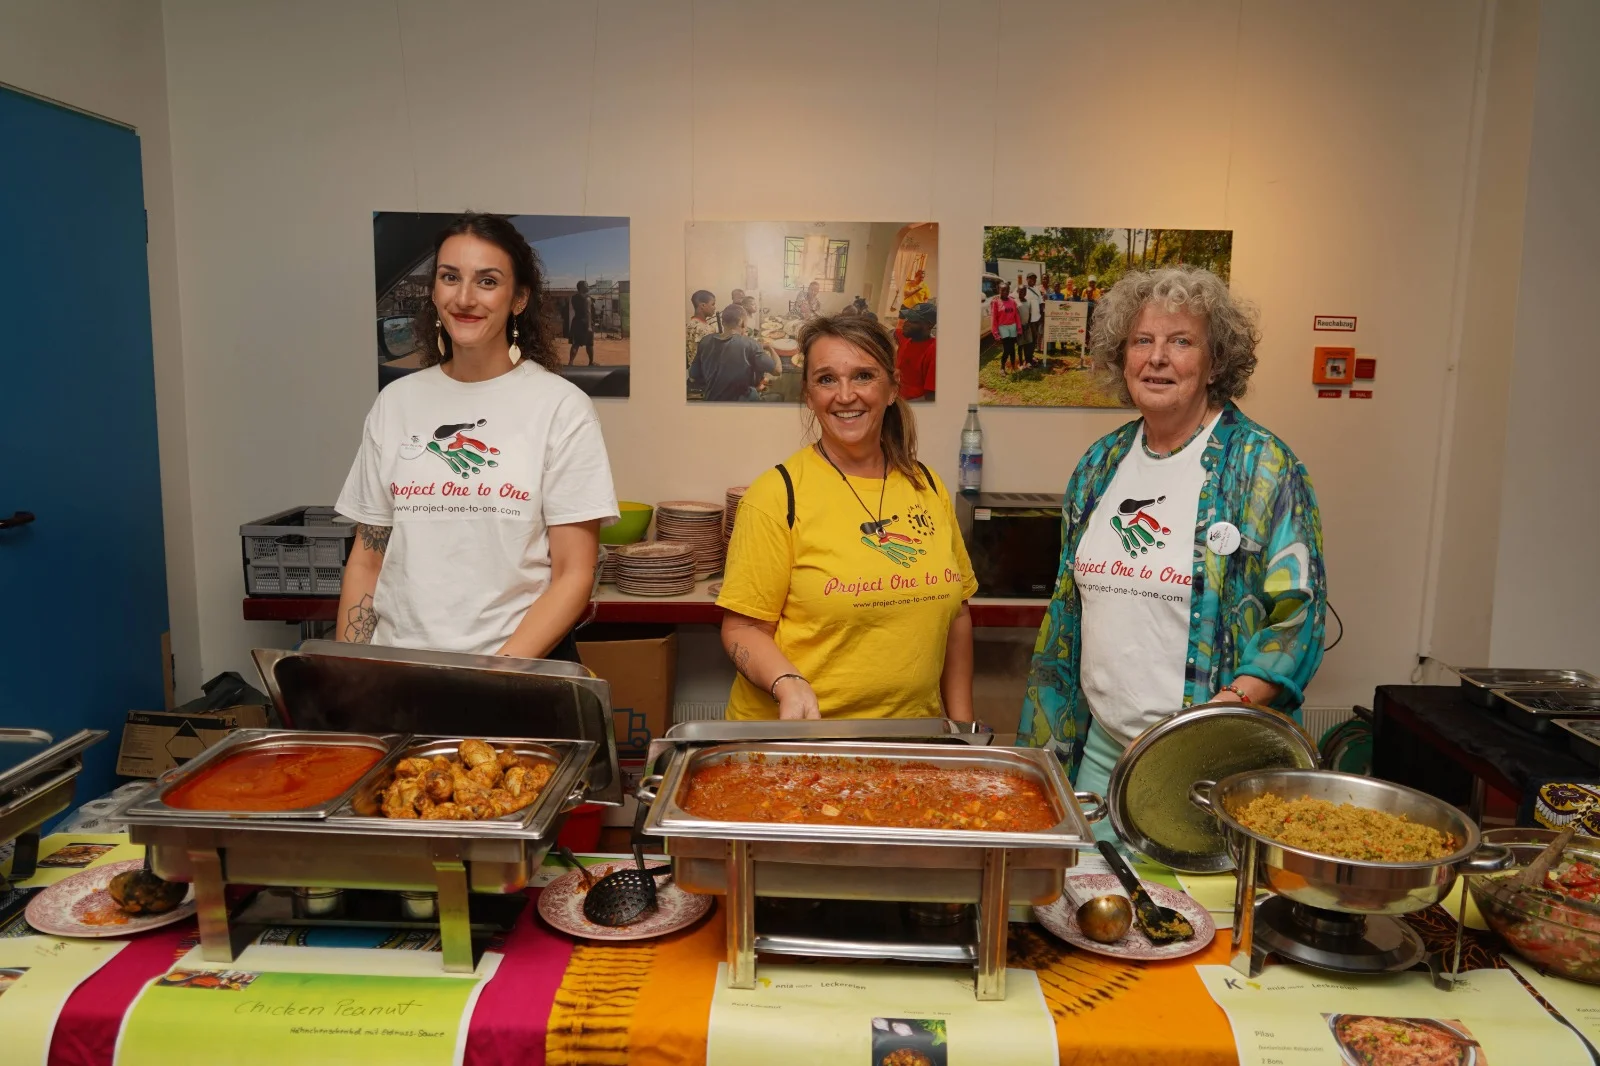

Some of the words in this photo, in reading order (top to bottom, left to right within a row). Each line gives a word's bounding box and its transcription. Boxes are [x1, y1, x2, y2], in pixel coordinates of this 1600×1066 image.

[1317, 320, 1353, 328] Rauchabzug
[441, 481, 471, 497] One
[477, 482, 492, 497] to
[499, 482, 532, 501] One
[1110, 560, 1135, 578] One
[1139, 564, 1153, 580] to
[1159, 566, 1193, 586] One
[824, 576, 884, 597] Project
[890, 574, 919, 590] One
[925, 571, 938, 586] to
[852, 593, 950, 608] www.project-one-to-one.com
[820, 982, 867, 991] Leckereien
[1223, 977, 1243, 991] K
[234, 1000, 325, 1016] Chicken
[333, 998, 424, 1017] Peanut
[364, 1027, 379, 1036] mit
[1254, 1030, 1275, 1038] Pilau
